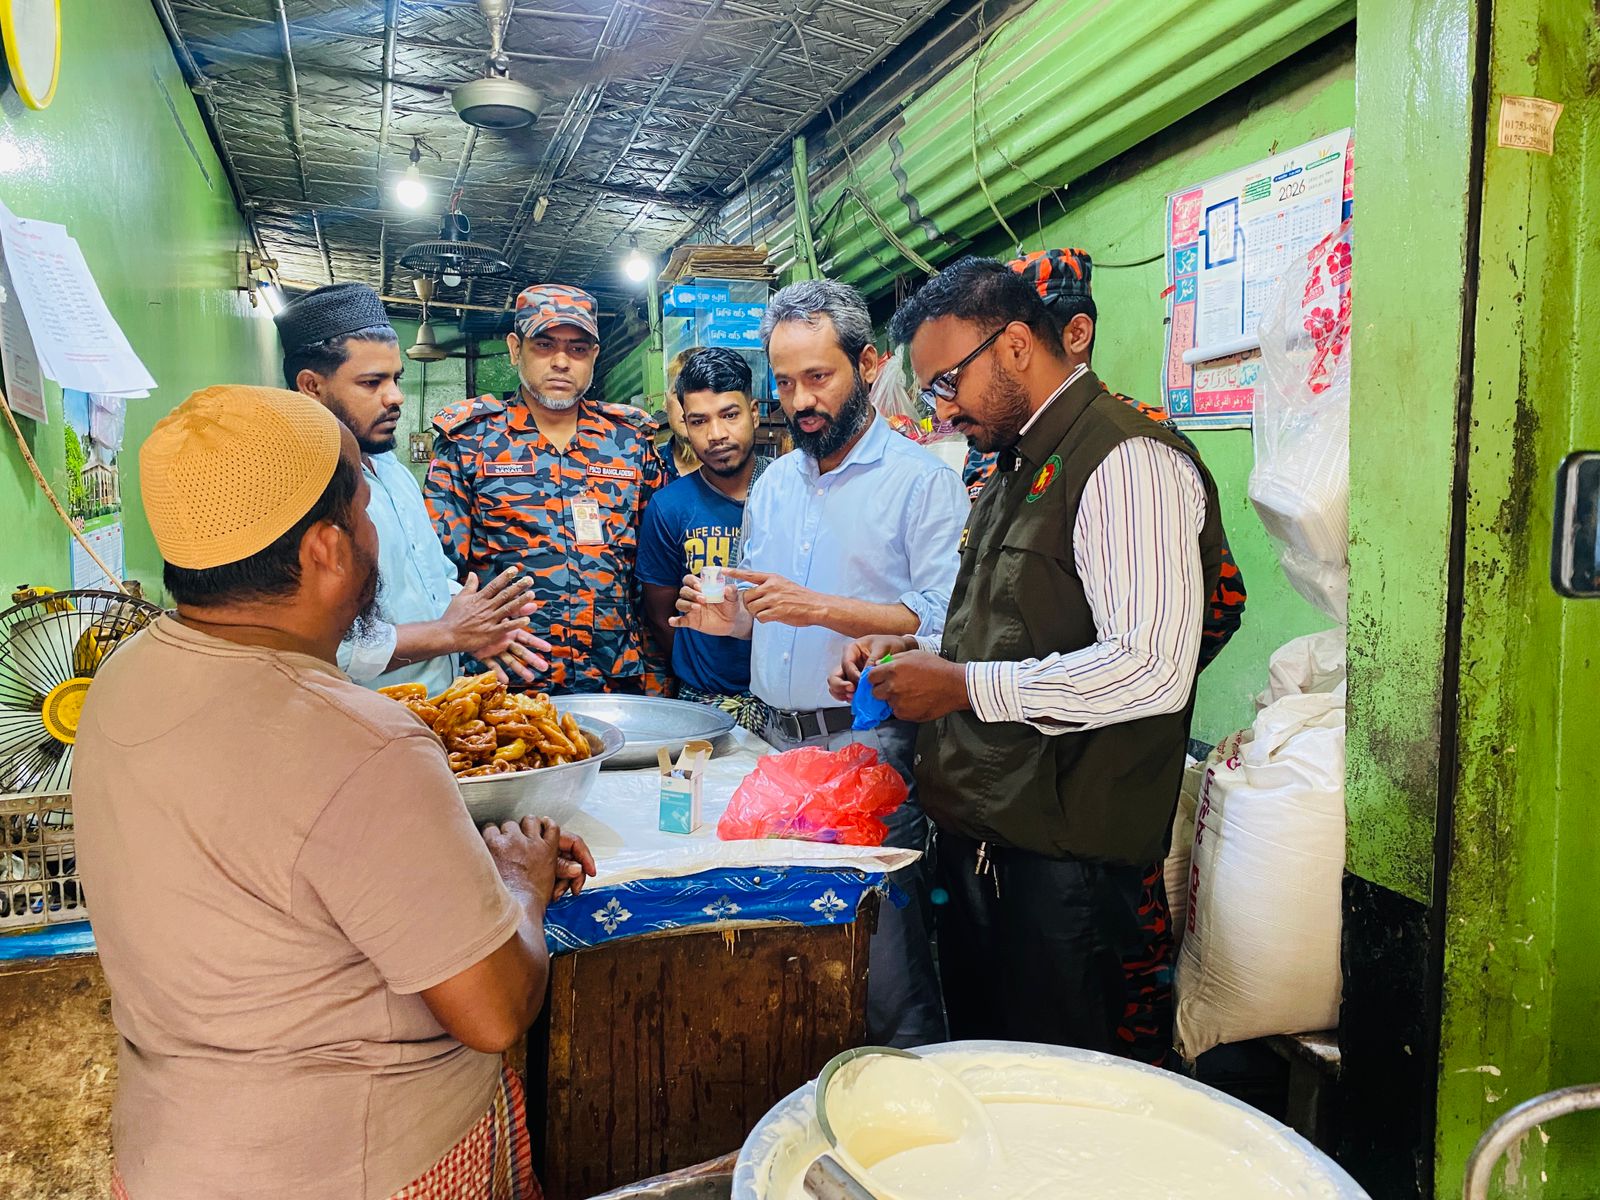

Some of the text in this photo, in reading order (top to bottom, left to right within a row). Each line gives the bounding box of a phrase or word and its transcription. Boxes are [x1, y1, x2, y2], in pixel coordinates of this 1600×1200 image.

[1278, 178, 1306, 202] 2026
[686, 526, 742, 539] LIFE IS LIK
